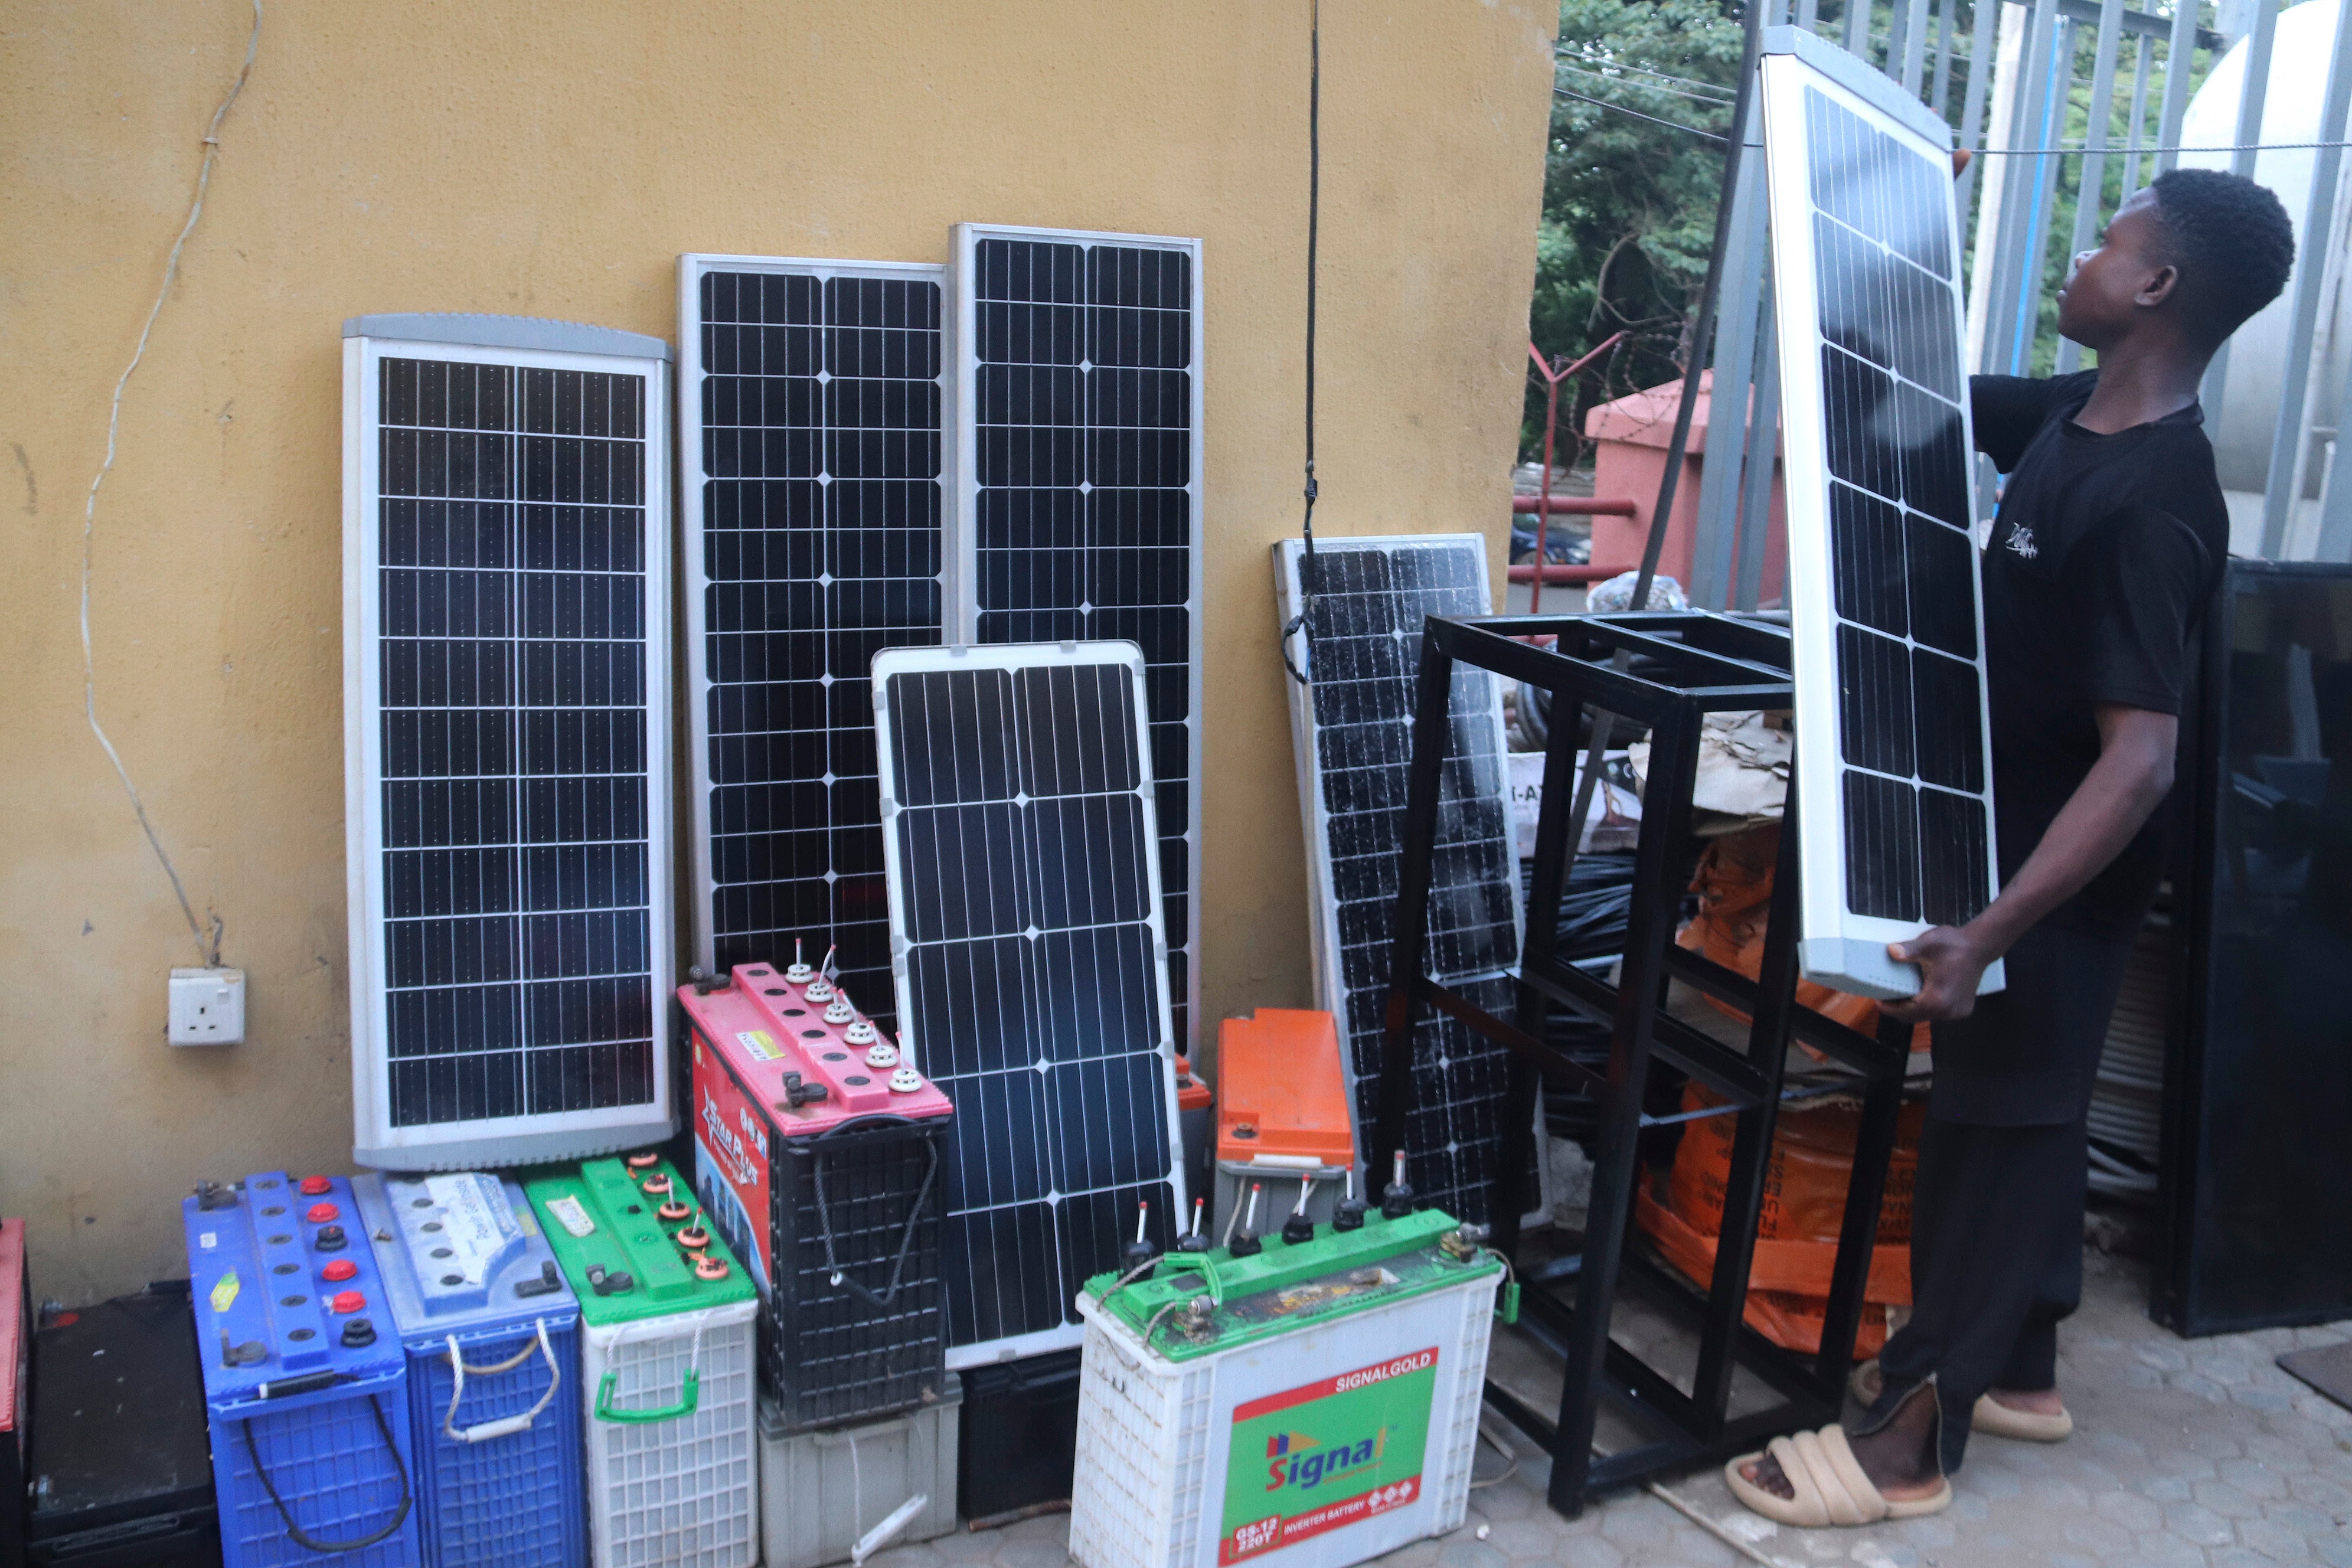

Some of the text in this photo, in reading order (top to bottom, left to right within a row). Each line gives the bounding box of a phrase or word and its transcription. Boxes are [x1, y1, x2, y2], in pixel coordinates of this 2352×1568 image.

[1265, 1427, 1387, 1492] Signal
[1283, 1513, 1326, 1536] INVERTER
[1327, 1500, 1366, 1521] BATTERY
